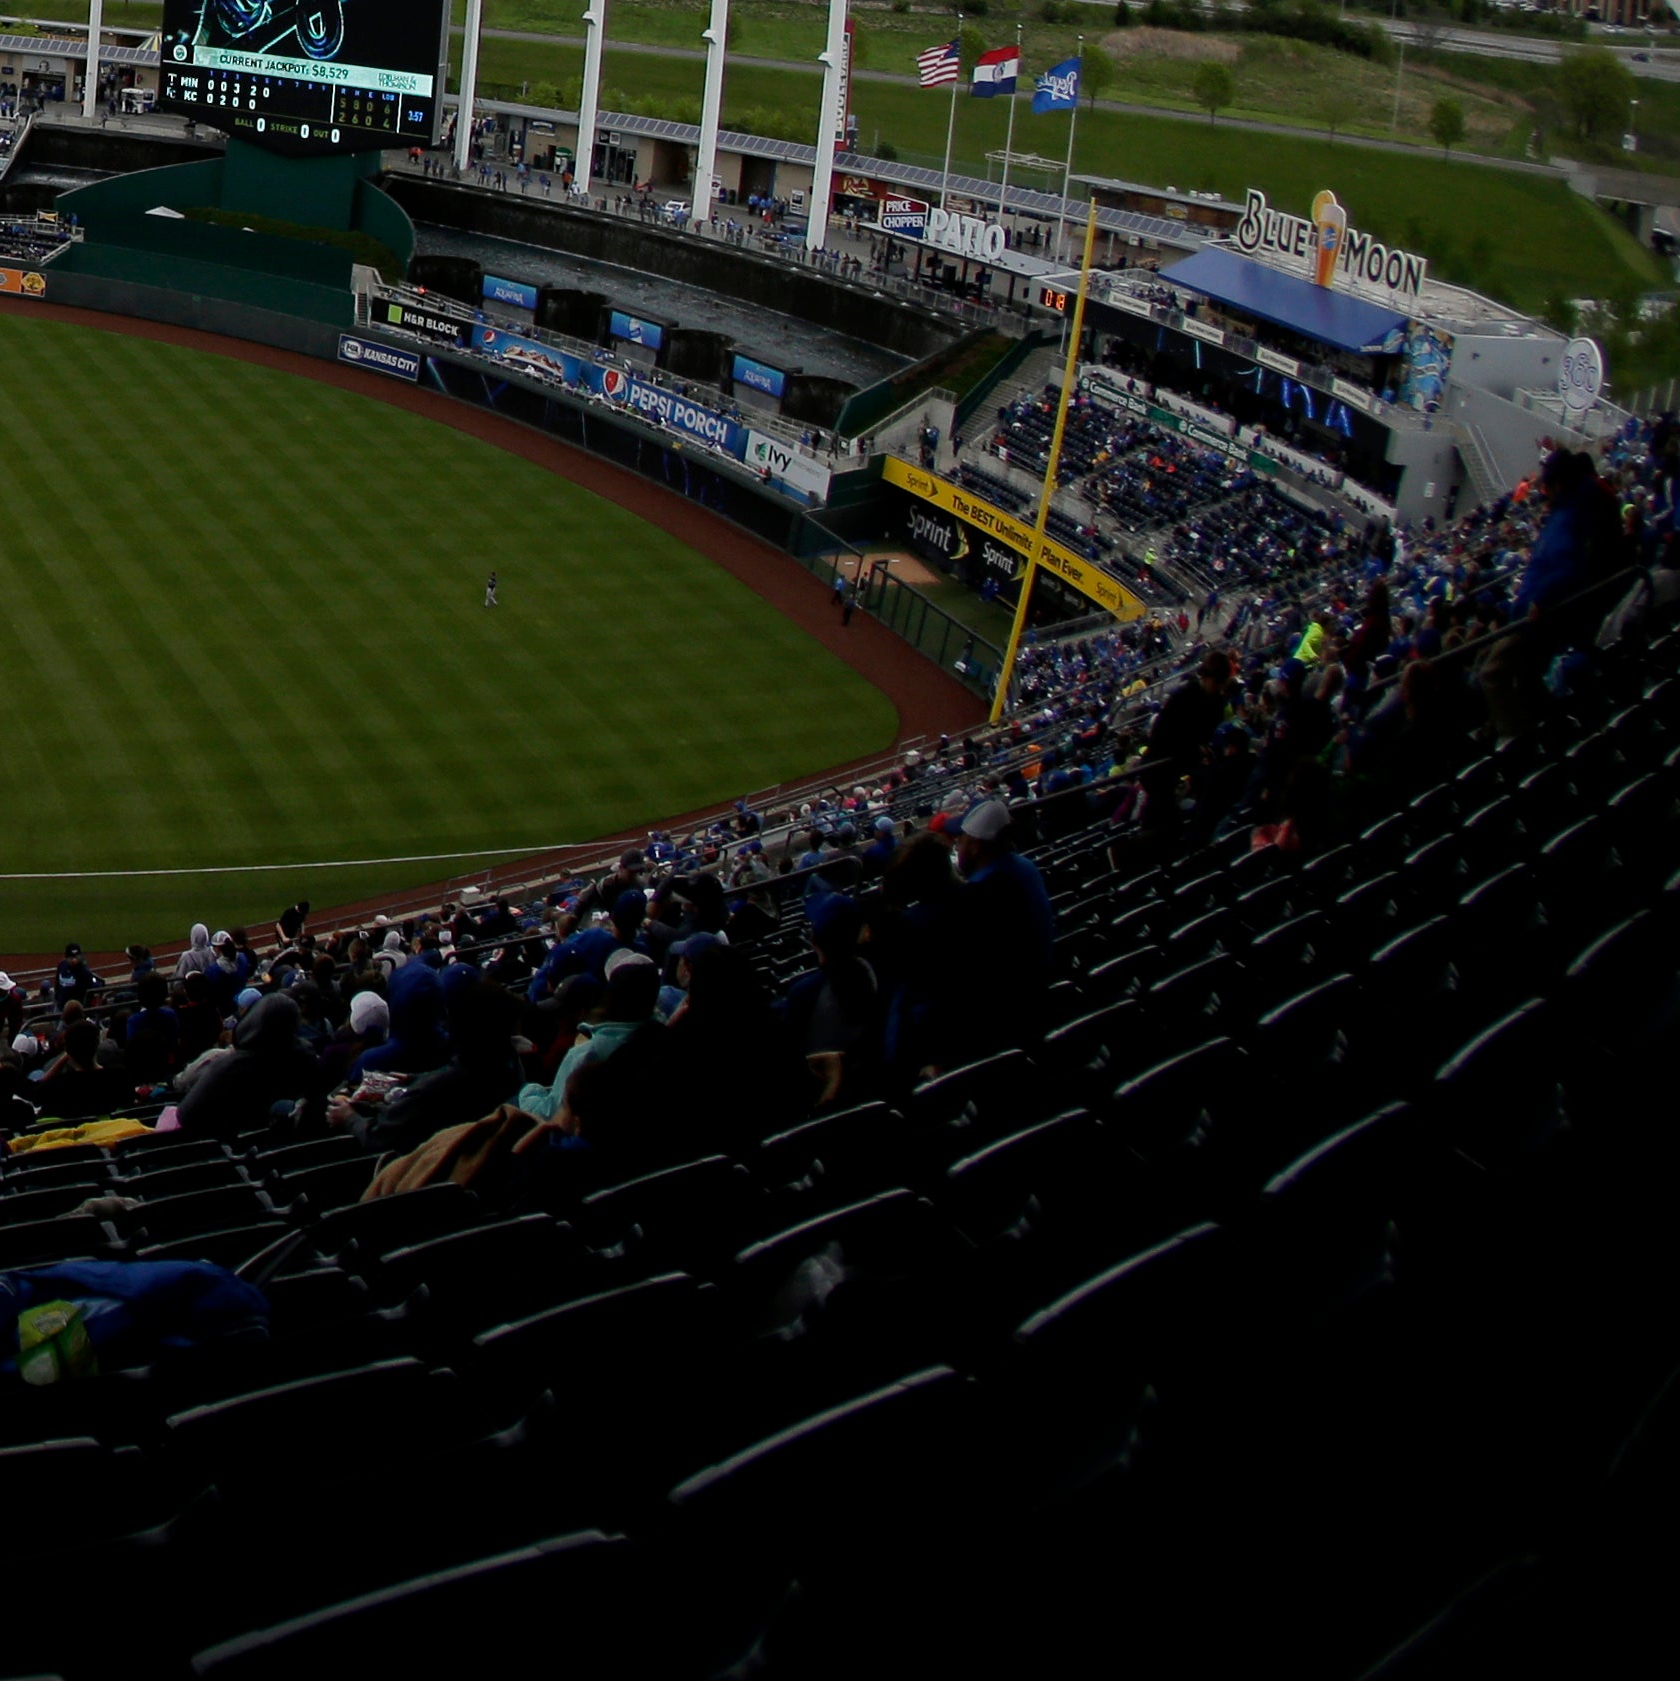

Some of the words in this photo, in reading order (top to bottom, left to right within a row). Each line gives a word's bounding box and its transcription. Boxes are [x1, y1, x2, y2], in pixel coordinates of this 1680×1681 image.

[220, 55, 263, 69] CURRENT
[264, 60, 309, 74] JACKPOT:
[312, 65, 349, 80] $8,529
[181, 76, 198, 89] MIN
[208, 80, 214, 91] 0
[221, 81, 227, 92] 0
[233, 83, 240, 94] 3
[250, 85, 257, 96] 2
[263, 87, 270, 98] 0
[340, 98, 347, 108] 5
[353, 99, 360, 110] 8
[367, 101, 373, 112] 0
[184, 90, 198, 102] KC
[207, 93, 213, 104] 0
[220, 95, 226, 105] 2
[232, 97, 239, 107] 0
[249, 99, 256, 110] 0
[339, 112, 346, 122] 2
[352, 113, 359, 124] 6
[365, 115, 372, 126] 0
[256, 118, 265, 132] 0
[270, 123, 298, 133] STRIKE
[300, 124, 310, 139] 0
[313, 129, 329, 138] OUT
[331, 129, 340, 143] 0
[883, 216, 924, 228] CHOPPER
[885, 200, 912, 213] PRICE
[930, 207, 1005, 260] PATIO
[1238, 188, 1312, 257] BLUE
[1344, 228, 1428, 297] MOON
[403, 312, 425, 327] H&R
[426, 318, 459, 336] BLOCK
[364, 348, 397, 367] KANSAS
[397, 357, 417, 372] CITY
[1560, 353, 1597, 393] 360
[1089, 381, 1128, 407] Commerce
[629, 384, 674, 417] PEPSI
[674, 402, 728, 443] PORCH
[768, 443, 792, 472] Ivy
[906, 472, 929, 492] Sprint
[906, 505, 953, 553] Sprint
[952, 494, 970, 514] The
[970, 504, 994, 528] BEST
[994, 516, 1034, 552] Unlimite
[1040, 545, 1062, 572] Plan
[982, 541, 1014, 576] Sprint
